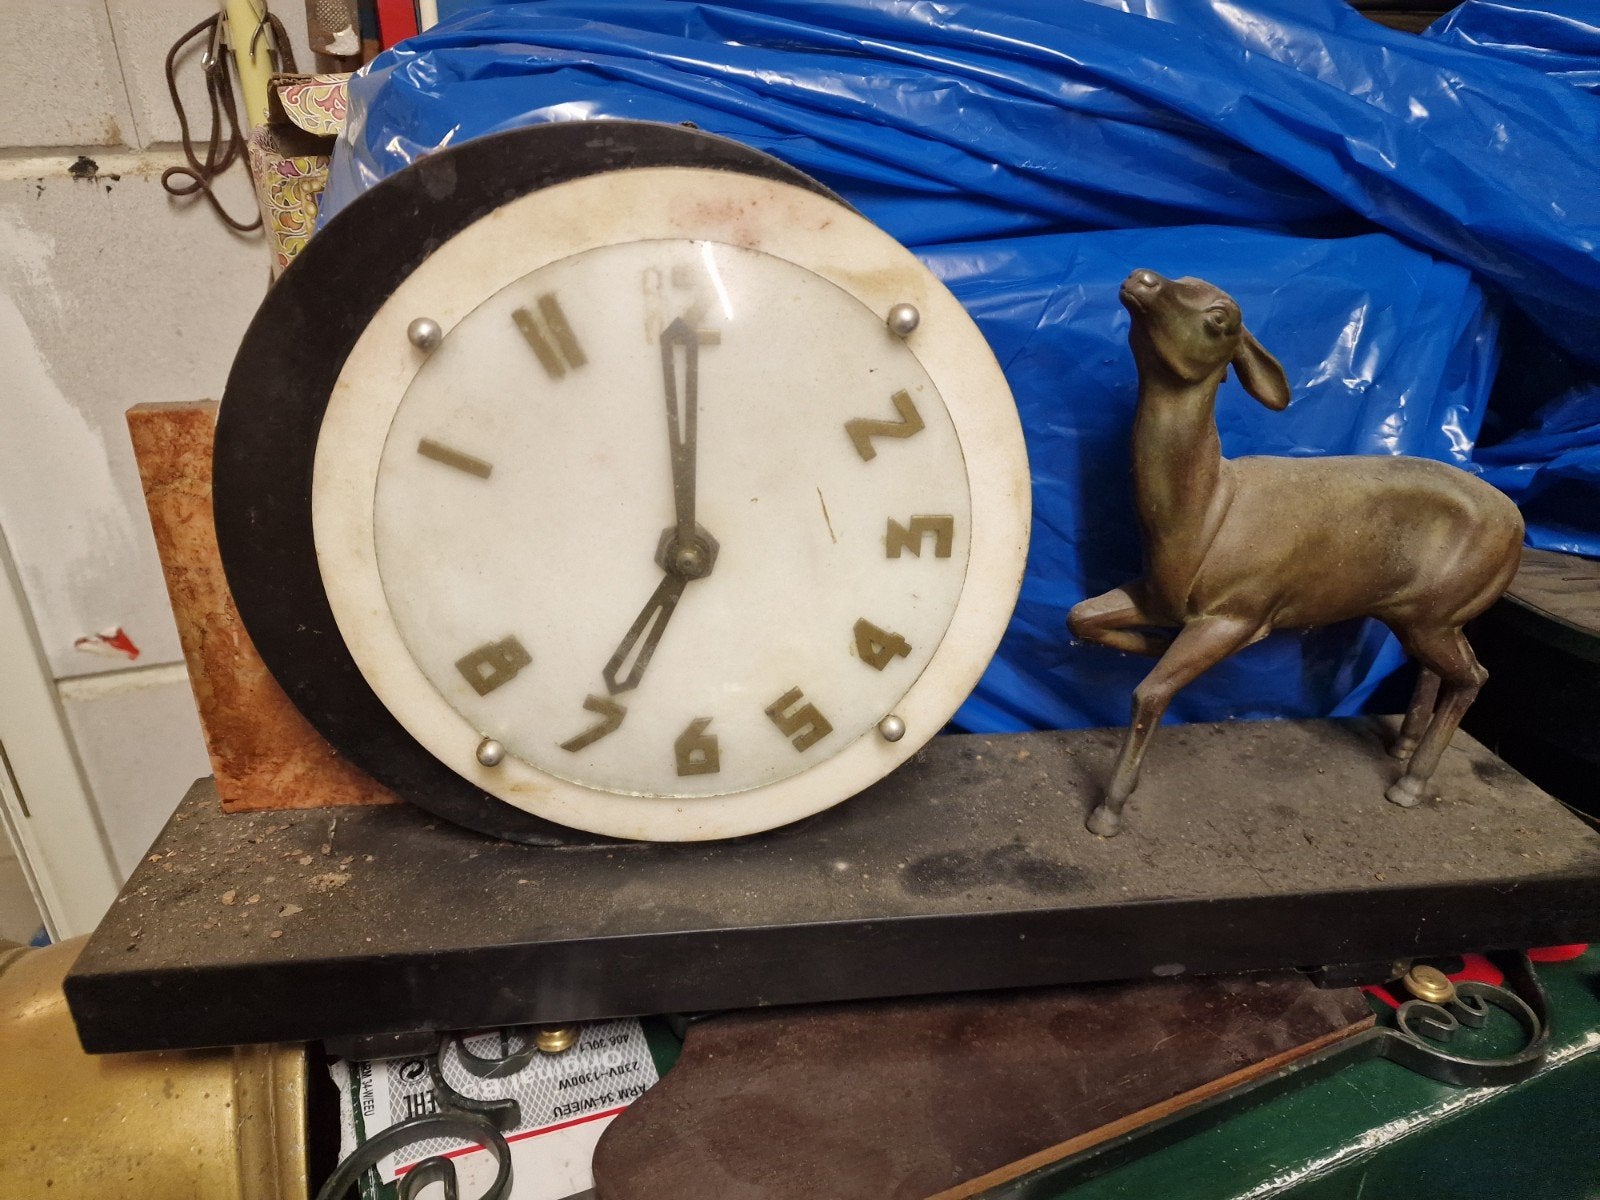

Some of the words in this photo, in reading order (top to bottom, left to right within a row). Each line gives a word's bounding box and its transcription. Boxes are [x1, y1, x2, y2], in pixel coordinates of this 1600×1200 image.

[511, 291, 589, 381] 11
[844, 389, 925, 462] 2
[886, 514, 954, 558] 3
[455, 634, 533, 697] 8
[852, 618, 913, 671] 4
[561, 694, 627, 753] 7
[675, 717, 721, 777] 6
[764, 686, 833, 752] 5
